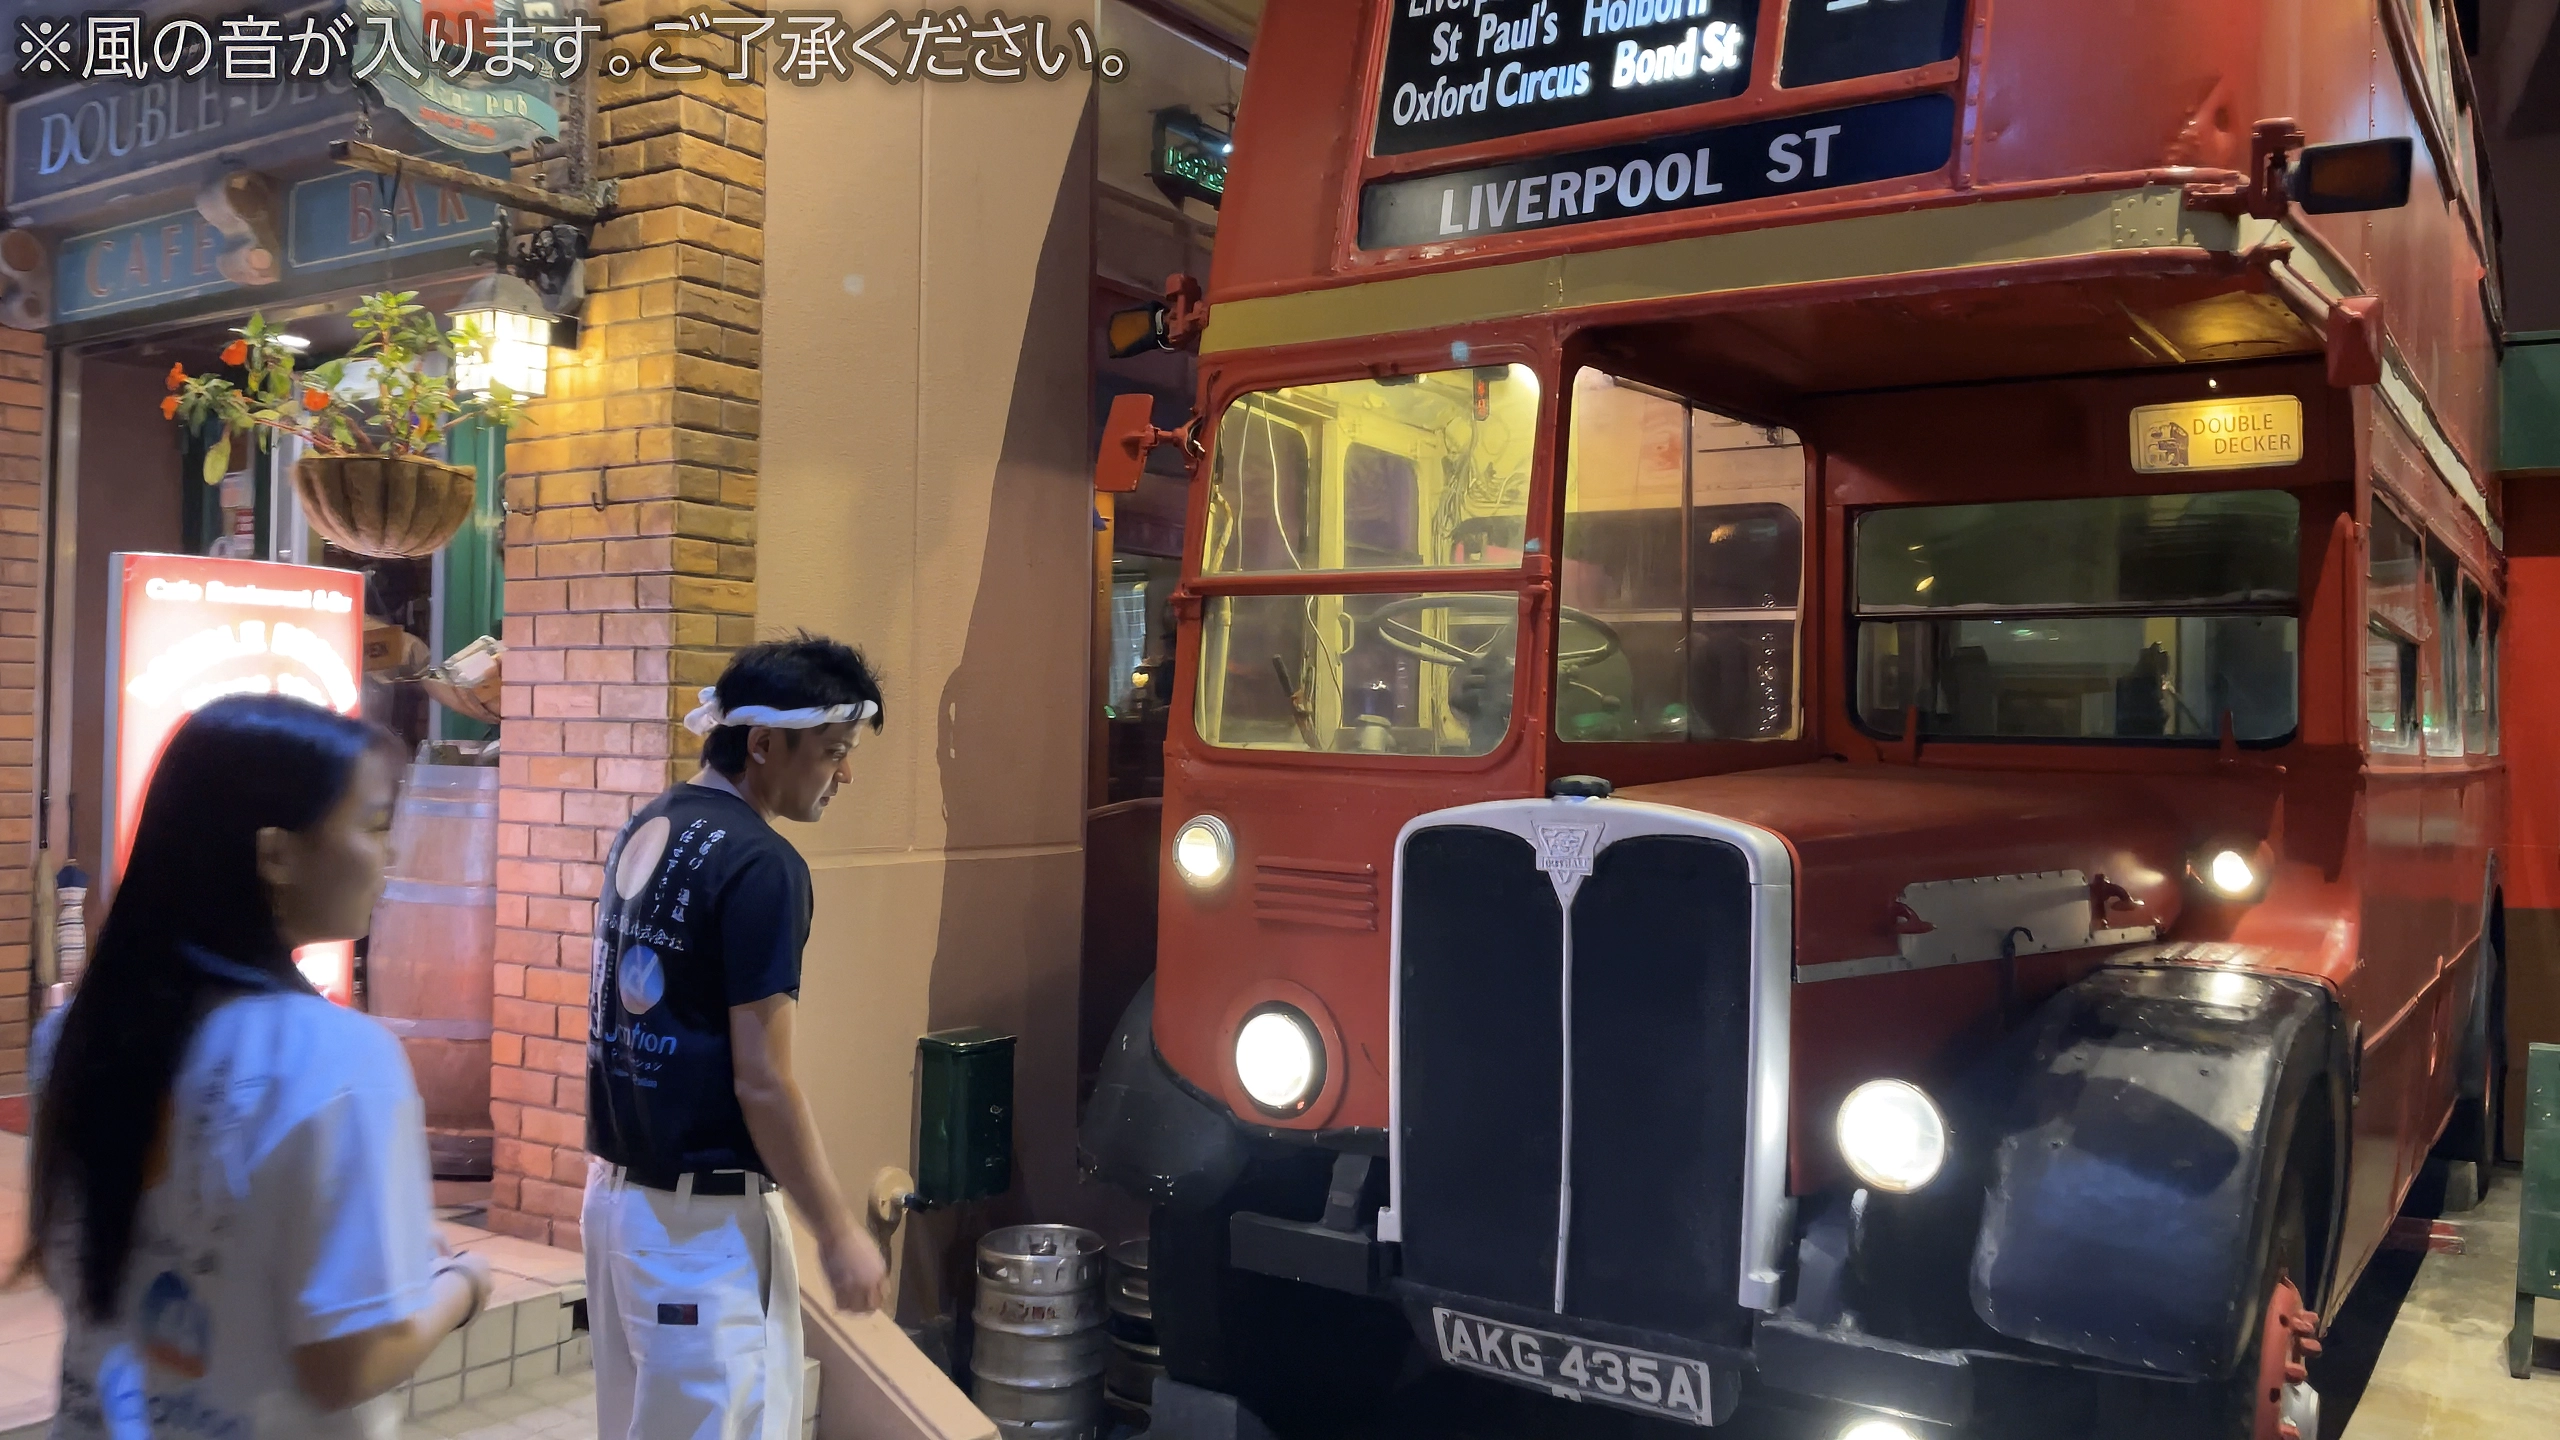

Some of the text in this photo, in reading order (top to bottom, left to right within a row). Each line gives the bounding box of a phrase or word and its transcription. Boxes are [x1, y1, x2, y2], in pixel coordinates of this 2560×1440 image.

[1430, 21, 1464, 66] St
[1475, 2, 1559, 58] Paul's
[1392, 21, 1743, 126] Oxford Circus Bond St
[348, 176, 471, 245] BAR
[1438, 125, 1842, 236] LIVERPOOL ST
[2193, 413, 2274, 436] DOUBLE
[2214, 433, 2292, 455] DECKER
[1451, 1318, 1699, 1412] AKG 435A
